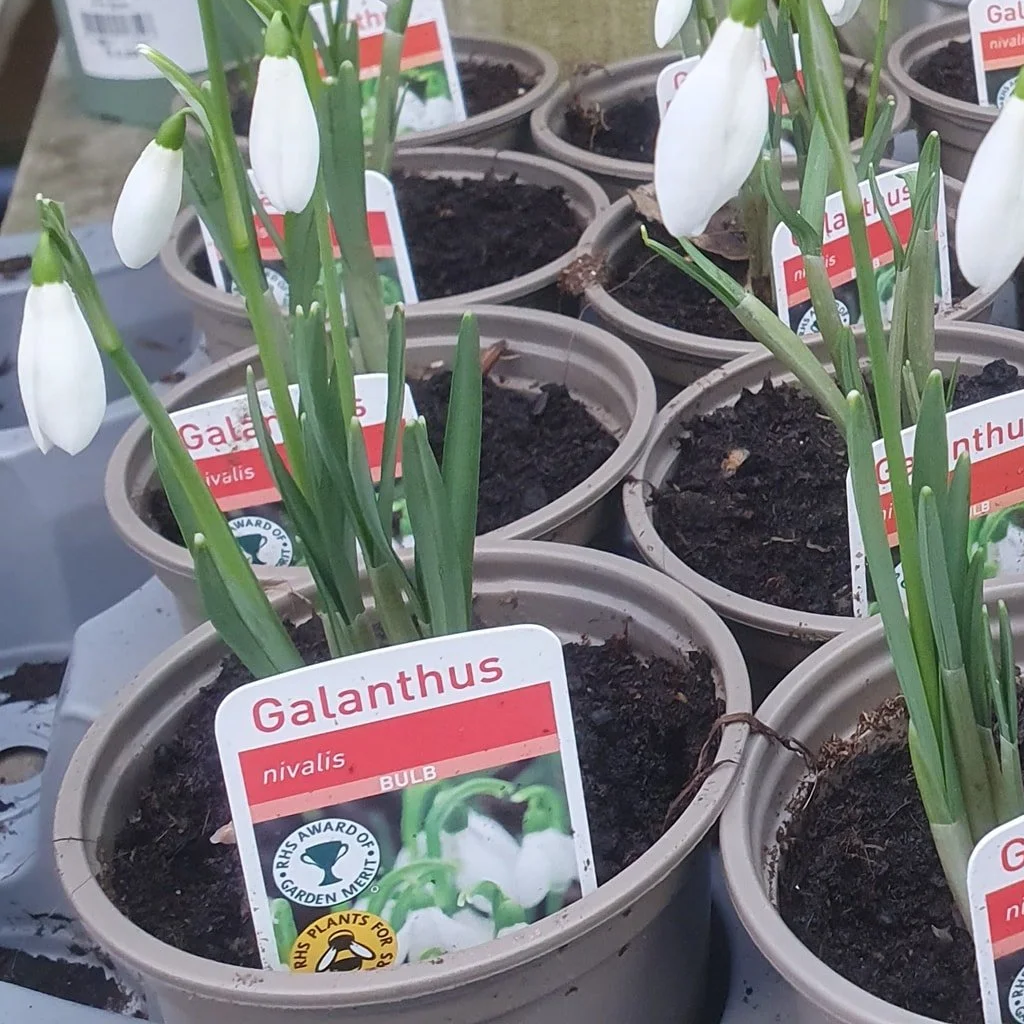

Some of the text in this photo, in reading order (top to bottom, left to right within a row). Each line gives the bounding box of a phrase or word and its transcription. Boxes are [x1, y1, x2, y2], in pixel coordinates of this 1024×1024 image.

[791, 185, 911, 247] latus
[794, 254, 836, 282] niis
[179, 398, 367, 450] Galans
[205, 465, 256, 487] ivalis
[272, 528, 287, 541] OF
[252, 655, 504, 733] Galanthus
[262, 749, 346, 785] nivalis
[379, 764, 437, 792] BULB
[276, 821, 375, 870] RHS AWARD OF
[280, 858, 377, 905] GARDEN MERIT
[293, 913, 394, 969] RHS PLANTS FOR
